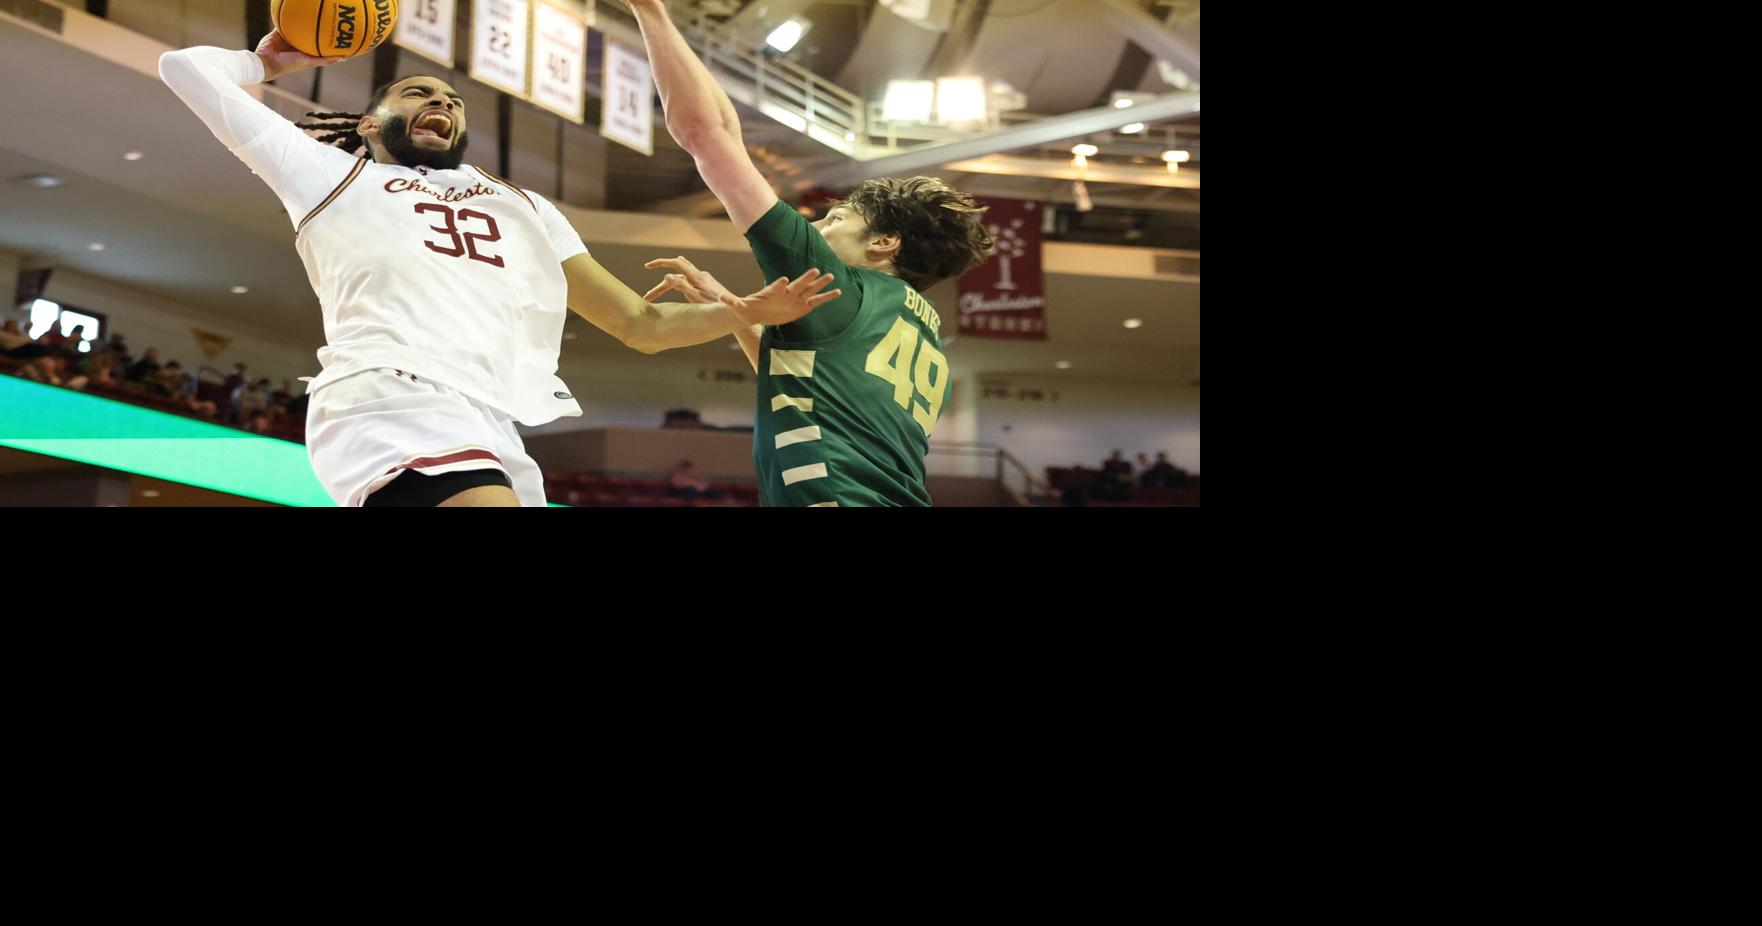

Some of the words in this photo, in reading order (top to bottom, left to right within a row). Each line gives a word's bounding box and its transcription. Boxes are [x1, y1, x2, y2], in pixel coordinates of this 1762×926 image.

[335, 5, 356, 49] NCAA
[488, 24, 511, 59] 22
[383, 178, 501, 202] Charlesto
[414, 202, 505, 268] 32
[865, 315, 950, 437] 49
